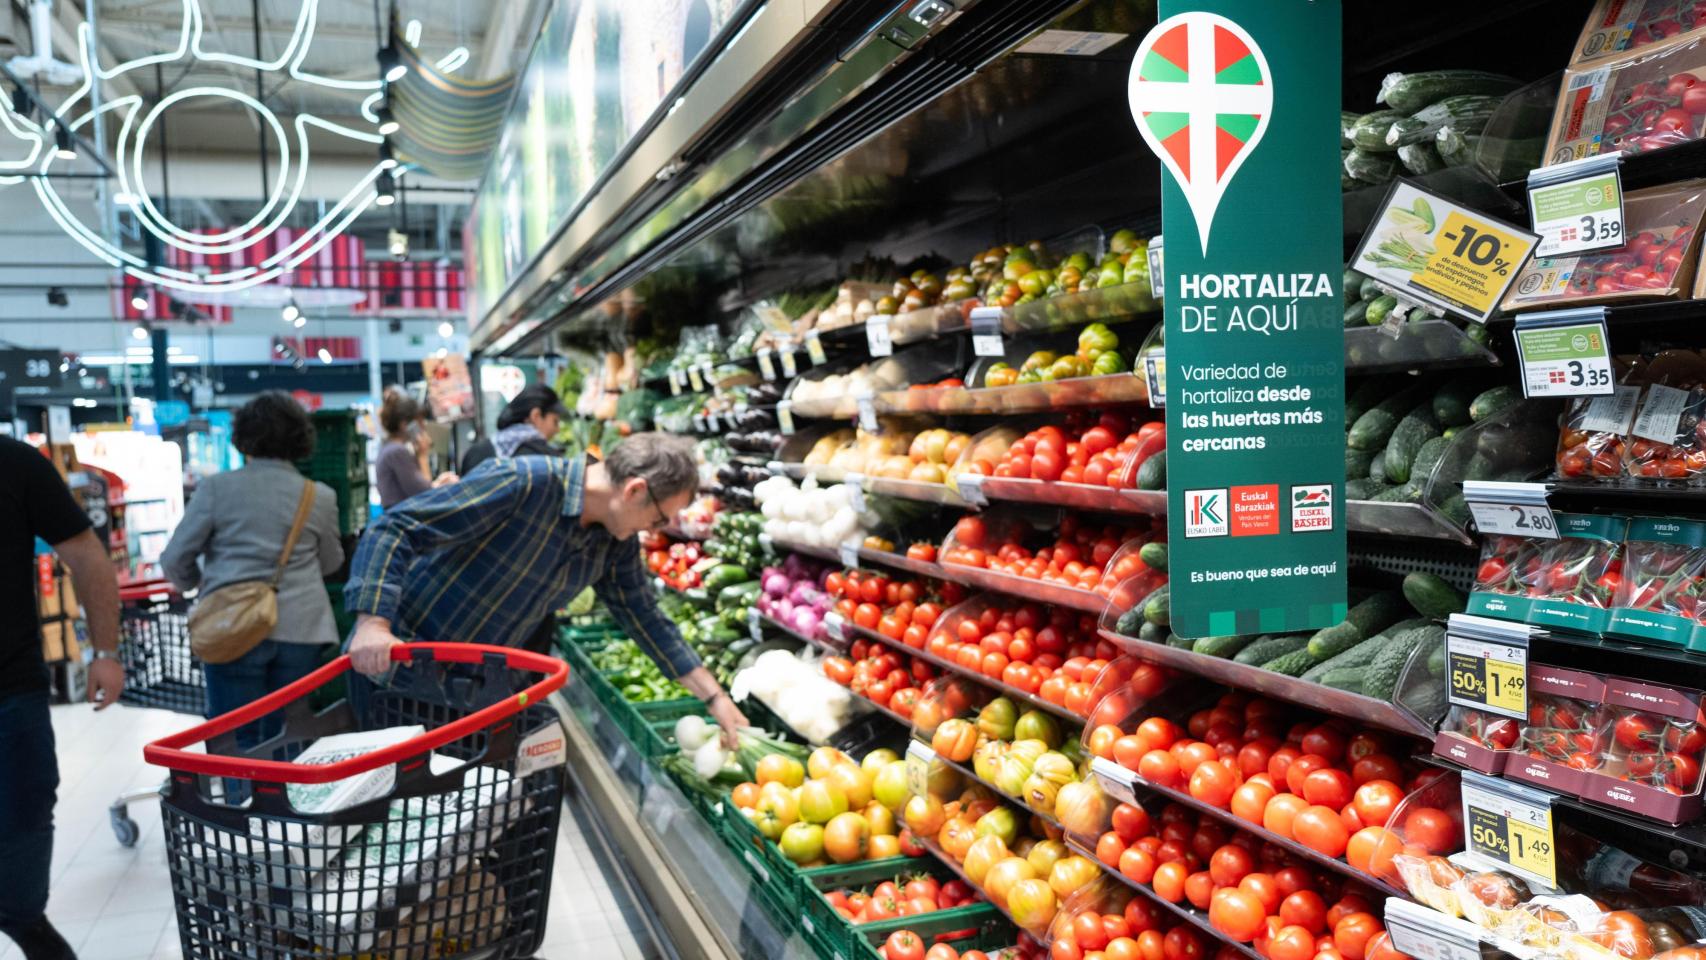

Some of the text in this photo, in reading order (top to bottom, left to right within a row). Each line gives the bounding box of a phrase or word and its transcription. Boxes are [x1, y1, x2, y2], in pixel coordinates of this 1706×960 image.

[1580, 215, 1621, 242] 3,59
[1435, 262, 1445, 270] en
[1451, 260, 1488, 280] descuento
[1180, 273, 1334, 299] HORTALIZA
[1426, 265, 1454, 282] endivias
[1461, 280, 1489, 296] pepinos
[1181, 305, 1217, 333] DE
[1226, 298, 1299, 336] AQUÍ
[1181, 362, 1260, 381] Variedad
[1264, 362, 1287, 379] de
[1568, 360, 1610, 387] 3,35
[1182, 386, 1254, 405] hortaliza
[1257, 385, 1312, 402] desde
[1182, 406, 1323, 428] las huertas más
[1182, 436, 1266, 452] cercanas
[1234, 502, 1275, 513] Barazkiak
[1241, 491, 1268, 502] Euskal
[1294, 517, 1330, 528] BASERRI
[1300, 508, 1325, 517] EUSKAL
[1509, 506, 1552, 531] 2,80
[1190, 561, 1337, 583] Es bueno que sea de aquí
[1453, 670, 1486, 694] 50%
[1490, 672, 1525, 697] 1,49
[1472, 824, 1509, 853] 50%
[1513, 832, 1550, 858] 1,49
